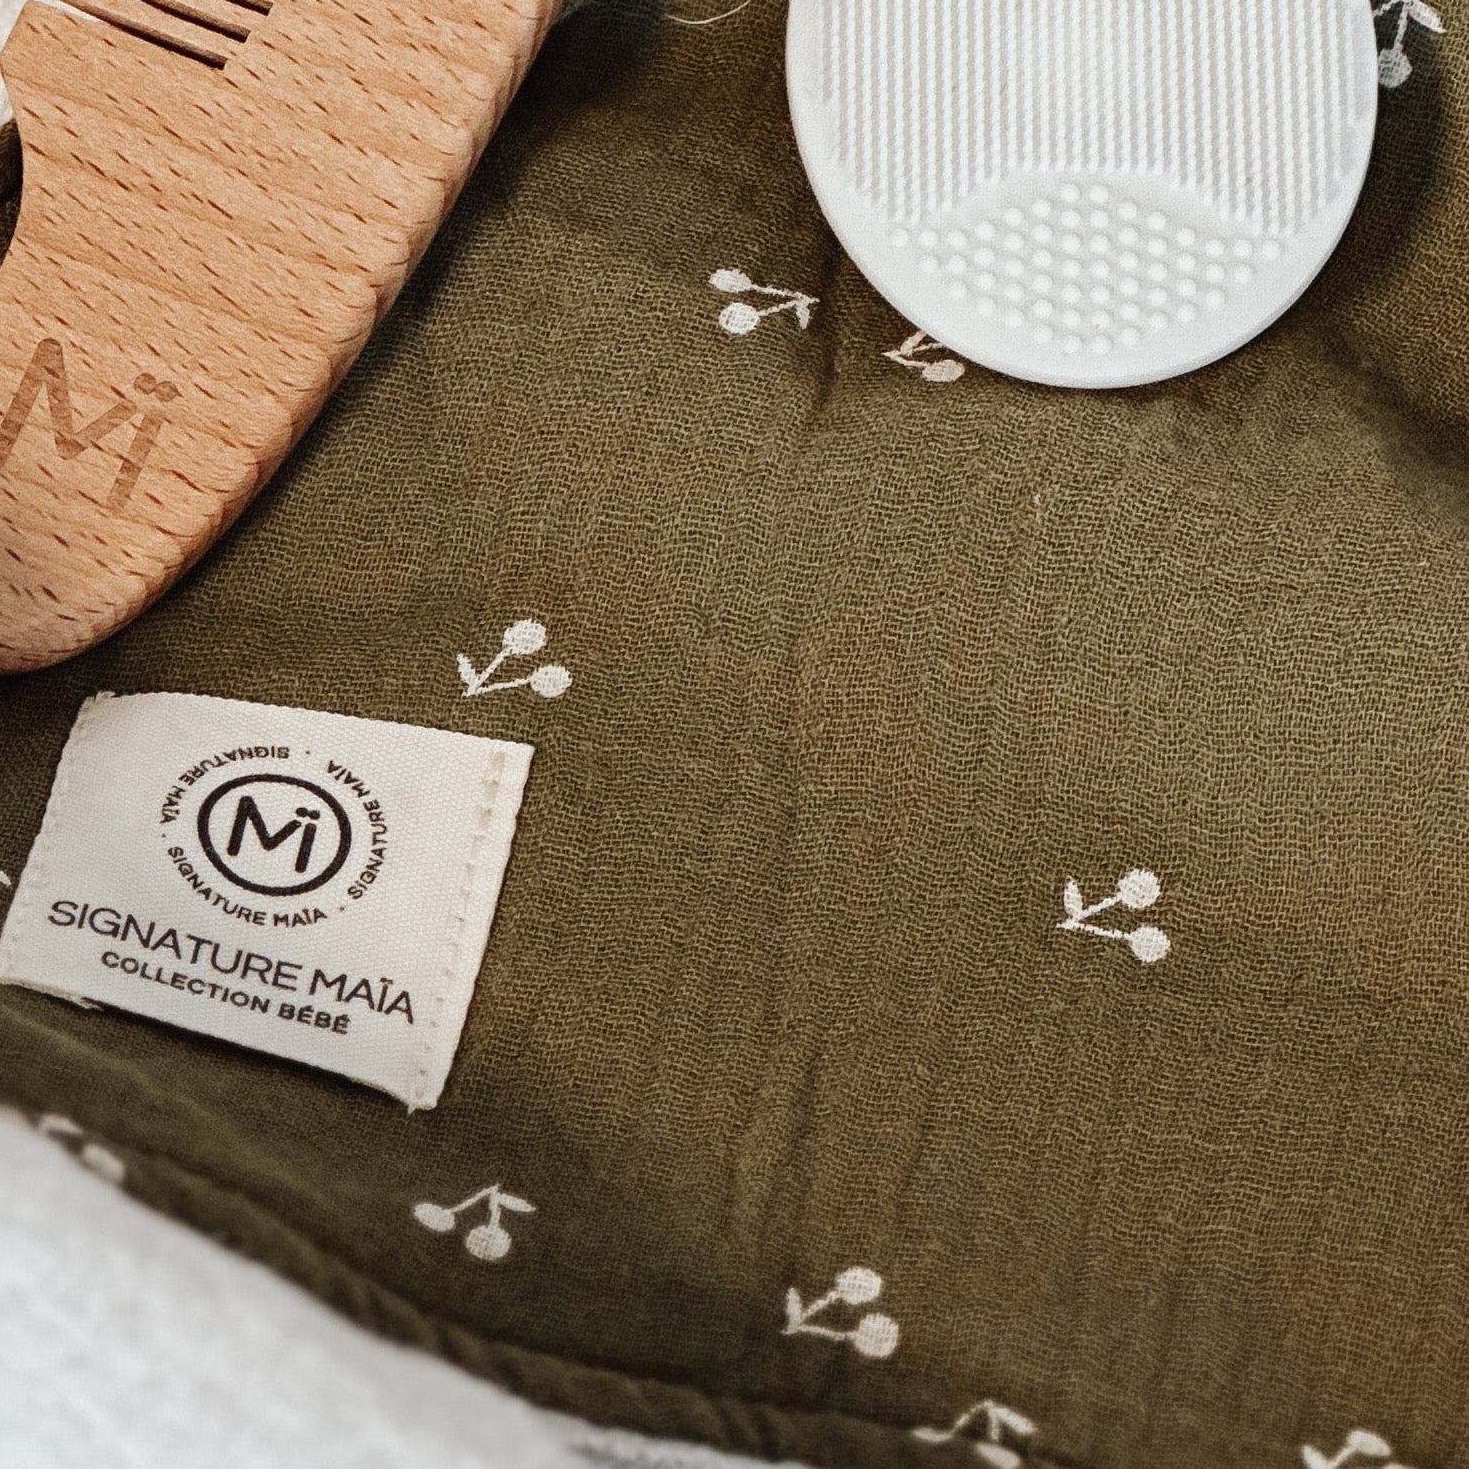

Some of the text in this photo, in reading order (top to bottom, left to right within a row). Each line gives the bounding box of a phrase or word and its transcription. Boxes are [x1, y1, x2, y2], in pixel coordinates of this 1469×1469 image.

[179, 745, 290, 787] SIGNATURE
[167, 845, 329, 928] SIGNATURE MAÏA
[346, 798, 389, 901] SIGNATURE
[47, 898, 415, 1025] SIGNATURE MAÏA
[100, 950, 352, 1036] COLLECTION BÉBÉ
